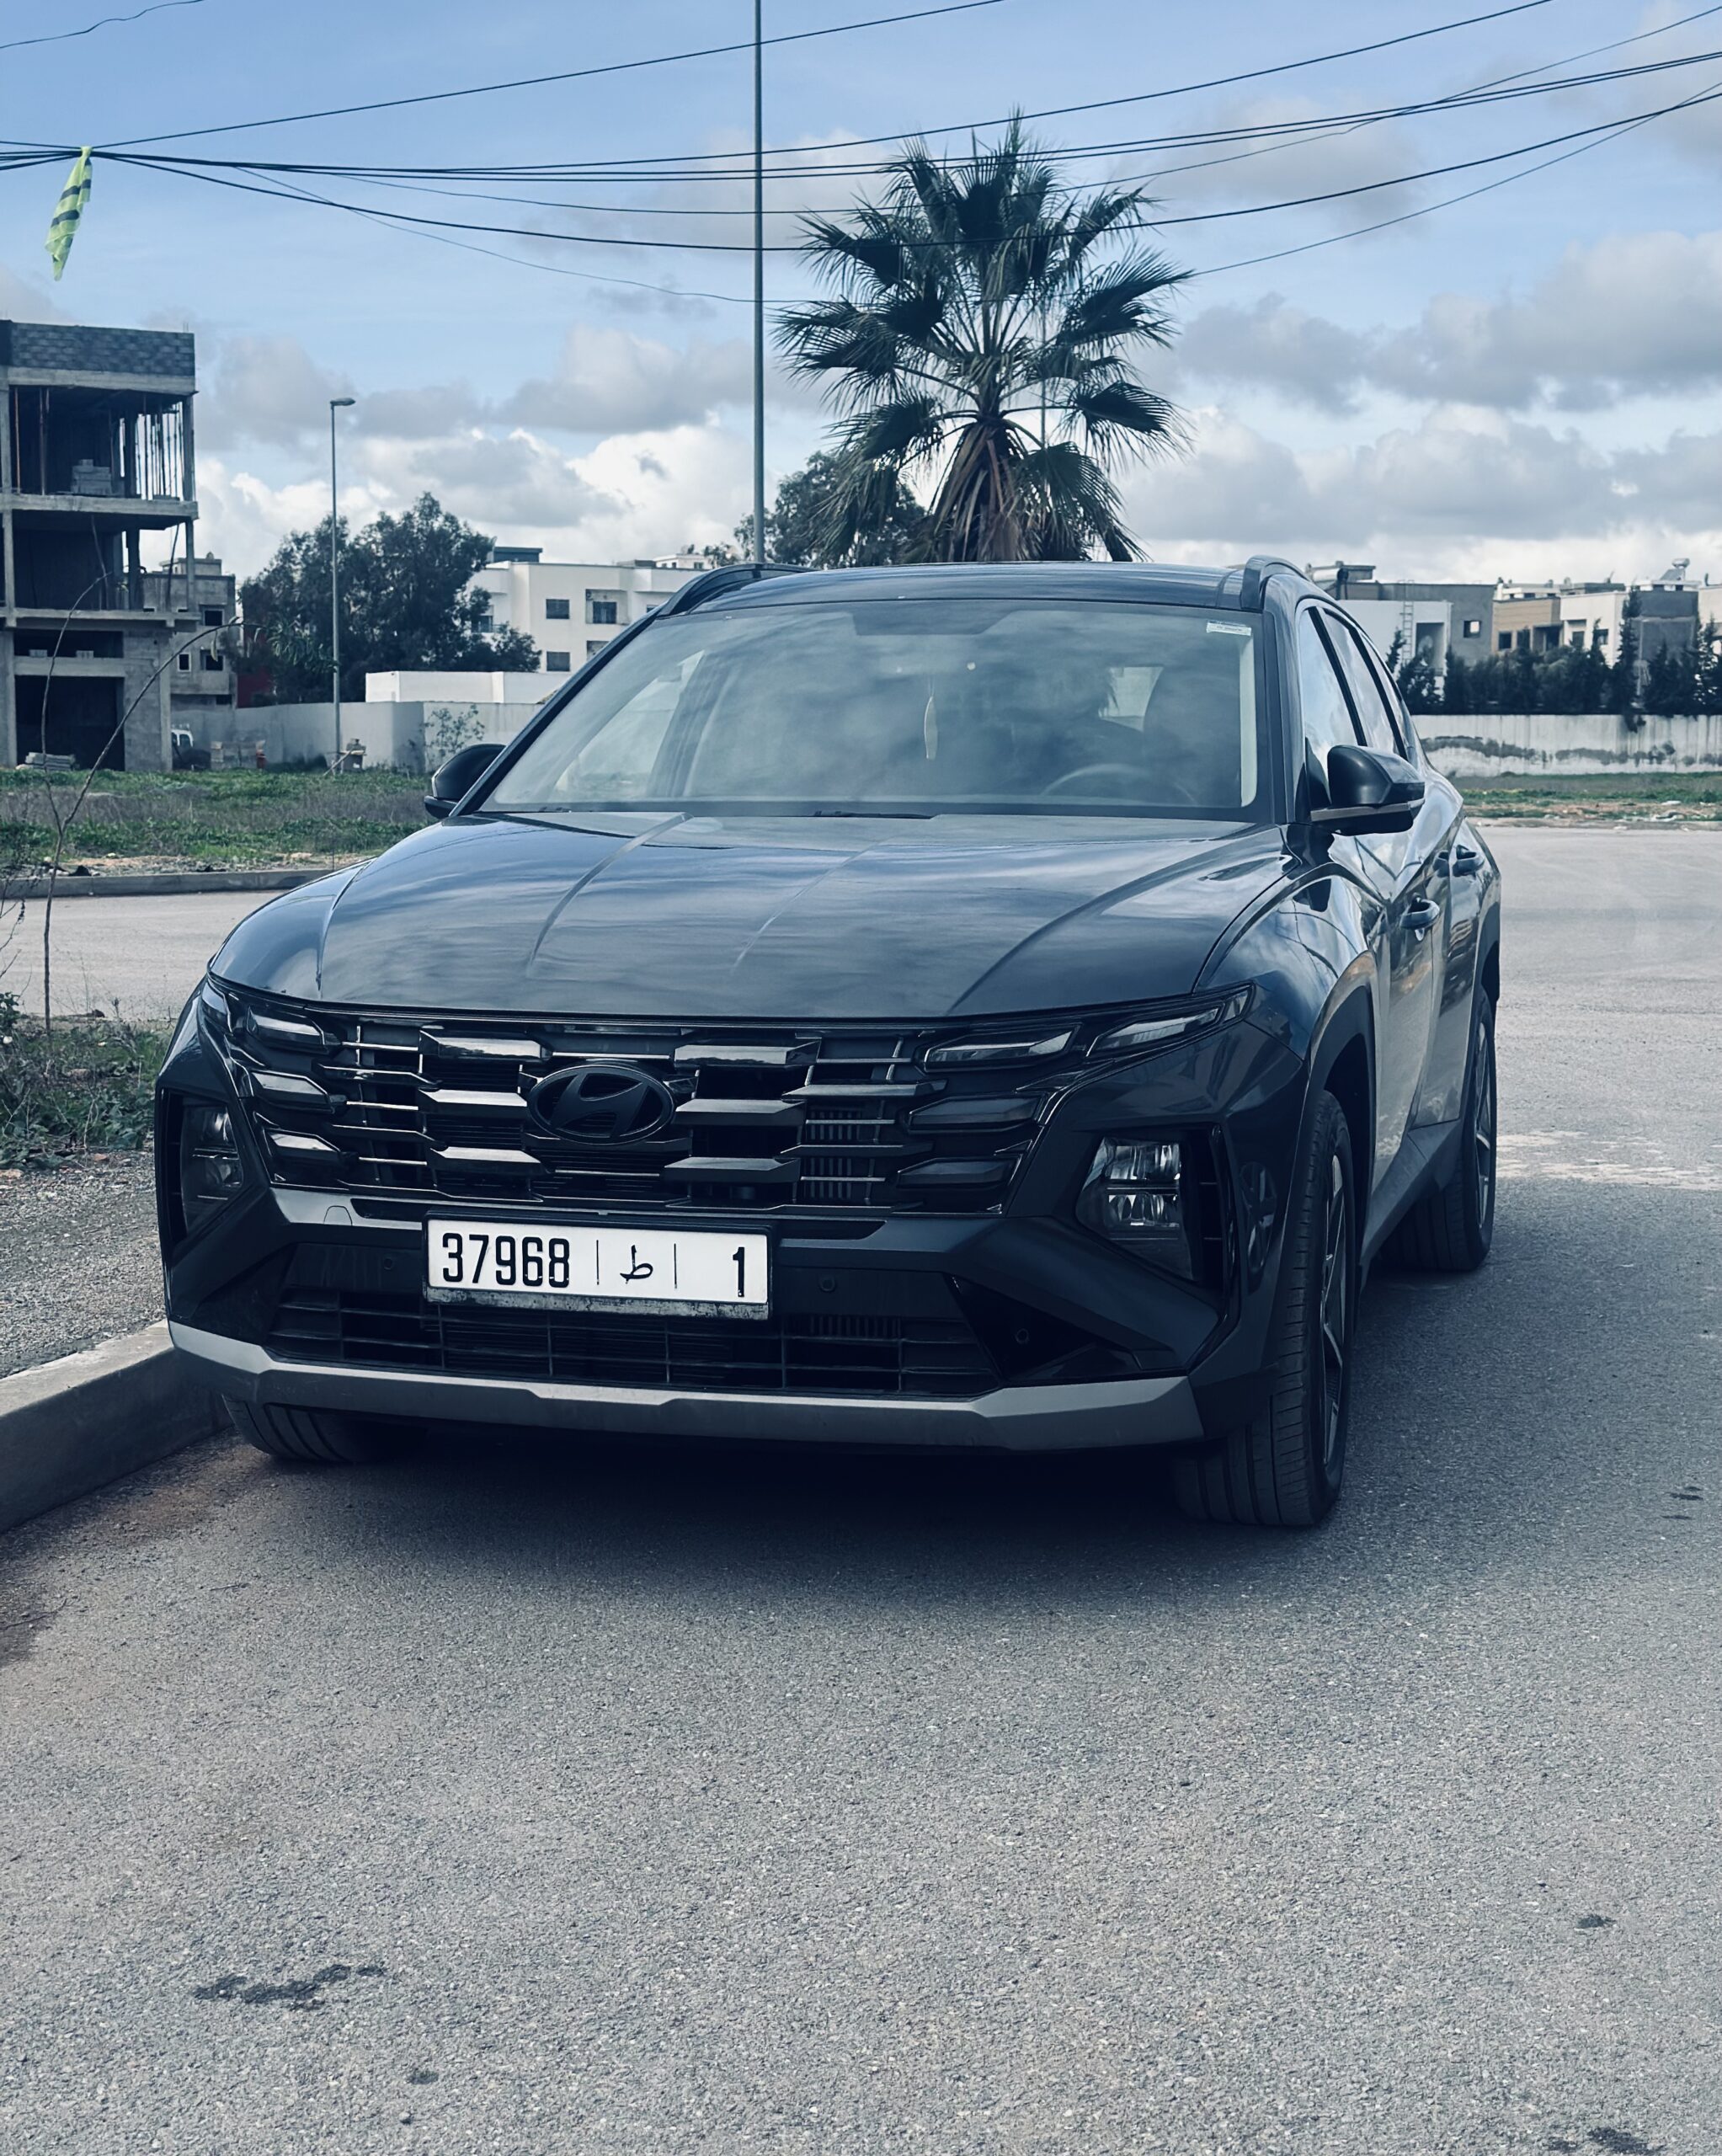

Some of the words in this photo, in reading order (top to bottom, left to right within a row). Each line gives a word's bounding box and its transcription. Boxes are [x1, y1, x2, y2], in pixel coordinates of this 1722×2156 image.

[442, 1232, 570, 1289] 37968
[619, 1245, 653, 1284] ط
[732, 1246, 745, 1298] 1
